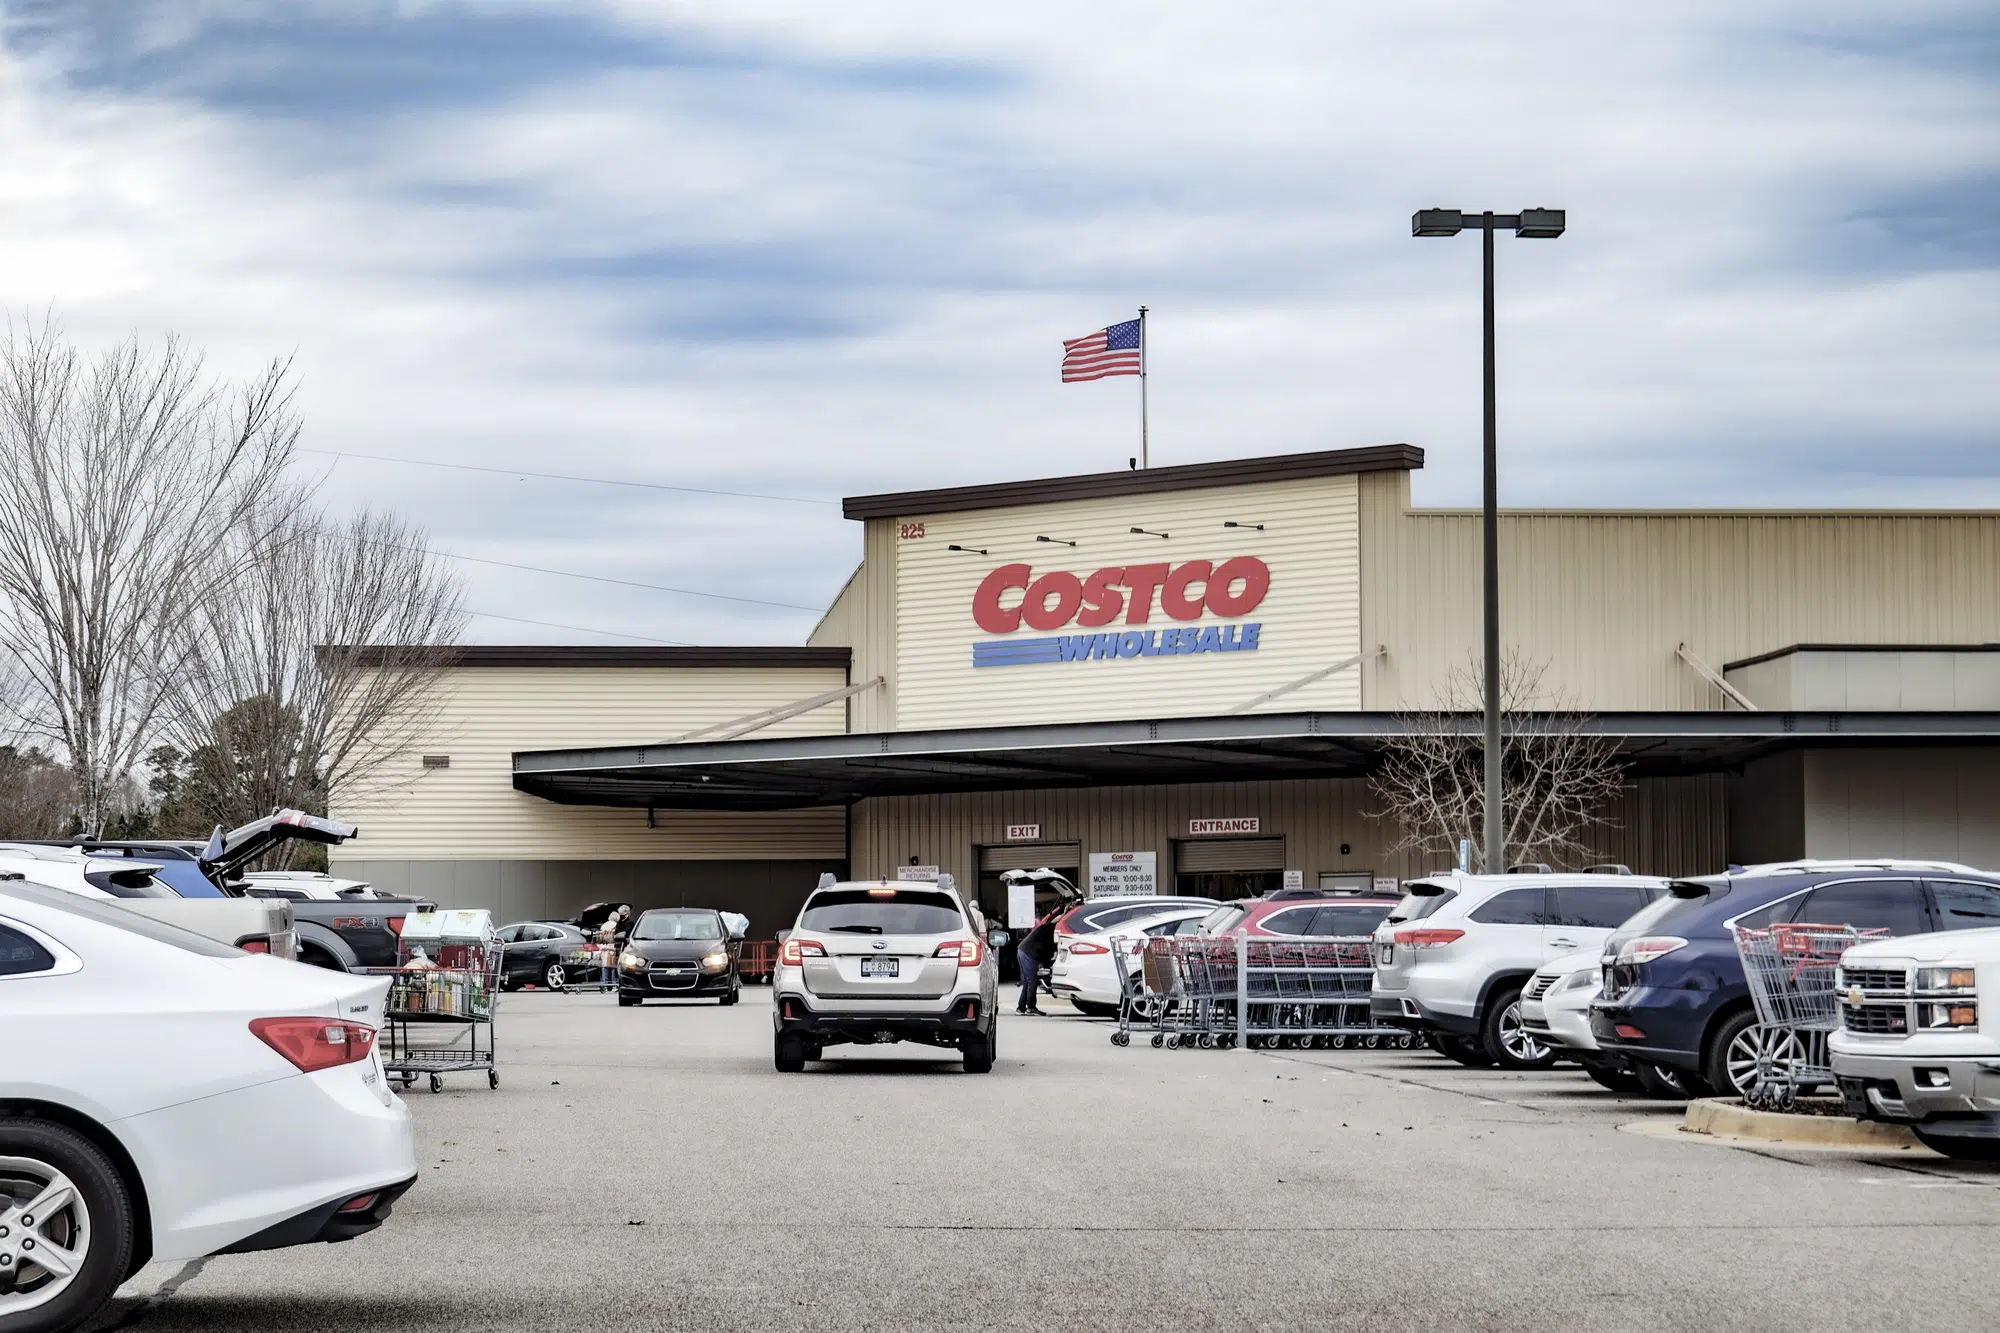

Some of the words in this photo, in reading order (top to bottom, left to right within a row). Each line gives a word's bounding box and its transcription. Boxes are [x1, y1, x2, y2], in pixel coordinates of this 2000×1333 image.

[901, 523, 925, 540] 825
[972, 556, 1270, 634] COSTCO
[1058, 623, 1262, 662] WHOLESALE
[1010, 826, 1037, 837] EXIT
[1191, 819, 1258, 832] ENTRANCE
[1129, 864, 1142, 872] ONLY
[1093, 884, 1120, 892] SATURDAY
[1124, 883, 1152, 891] 9:30-6:00
[333, 916, 379, 929] FX4
[877, 962, 895, 971] 8794
